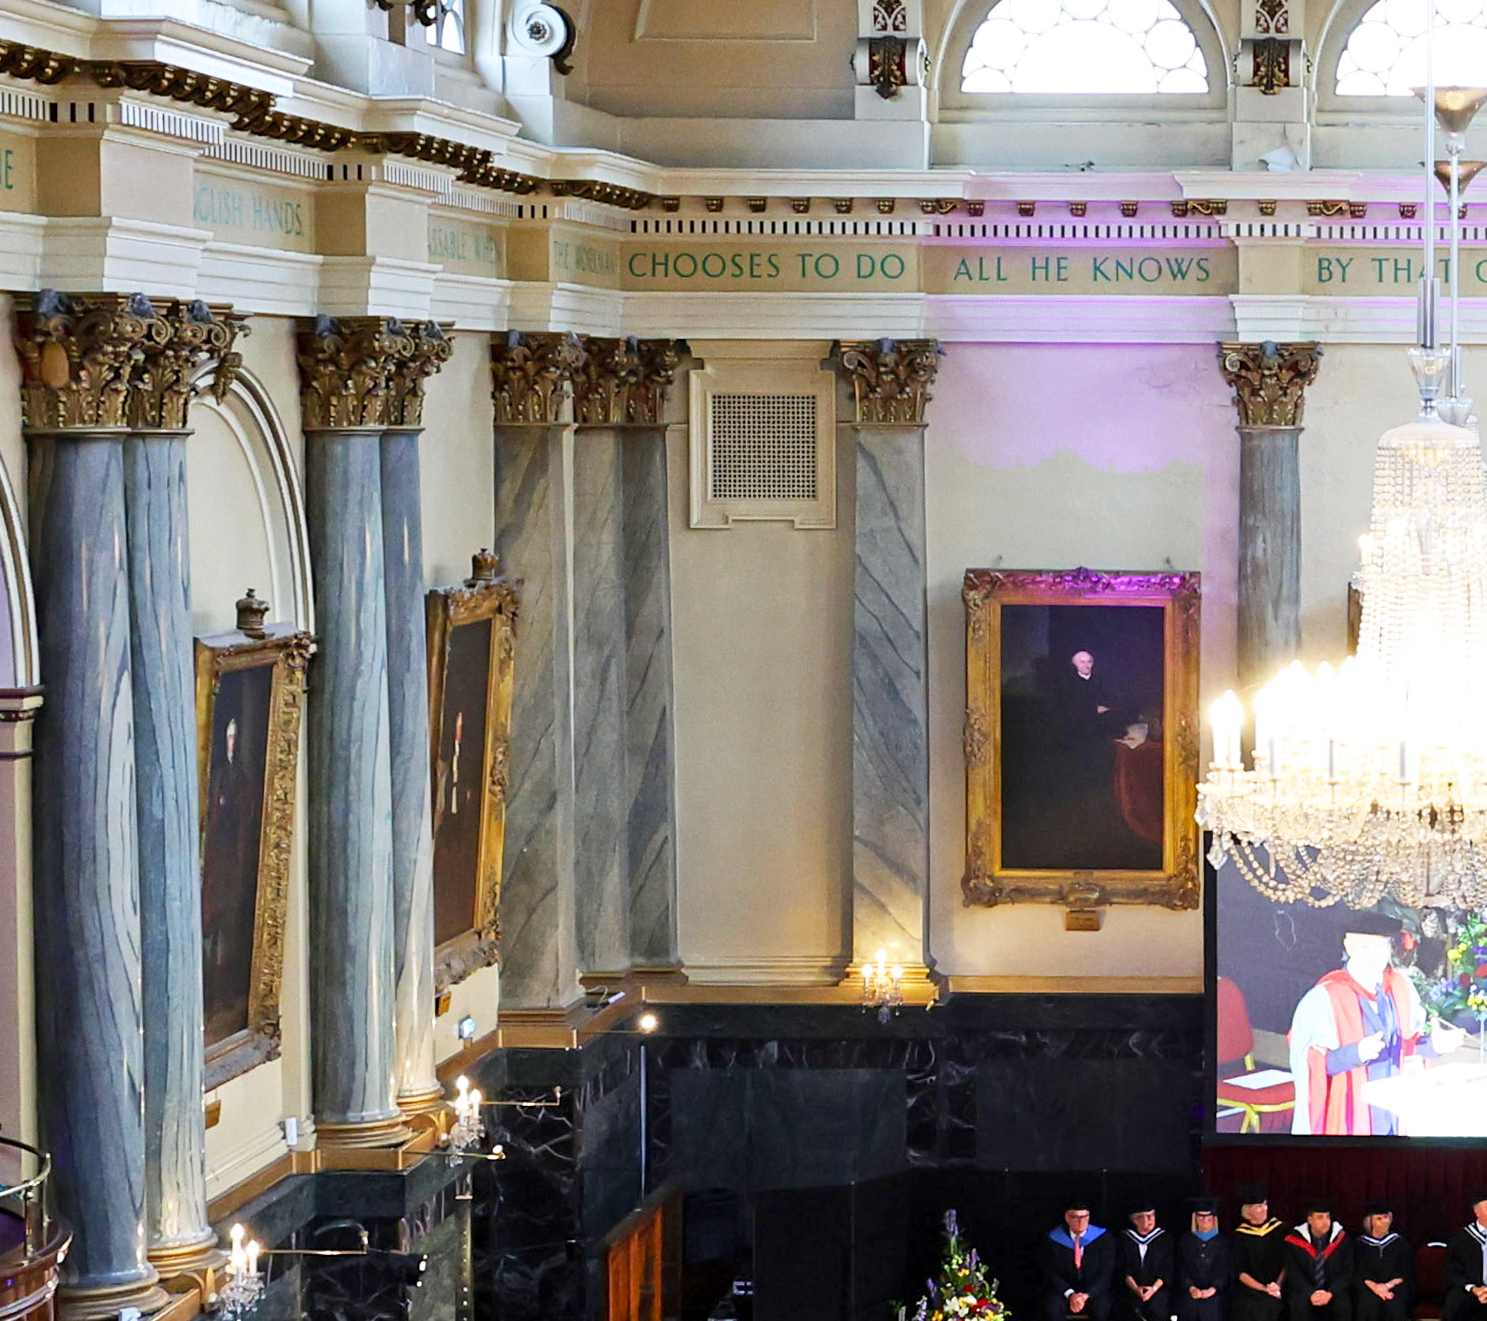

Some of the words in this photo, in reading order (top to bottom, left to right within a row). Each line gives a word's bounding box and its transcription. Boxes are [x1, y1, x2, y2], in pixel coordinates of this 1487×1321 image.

[628, 252, 781, 280] CHOOSES
[796, 253, 840, 279] TO
[856, 253, 905, 279] DO
[953, 257, 1008, 282] ALL
[1030, 257, 1069, 282] HE
[1091, 256, 1211, 283] KNOWS
[1317, 257, 1354, 284] BY
